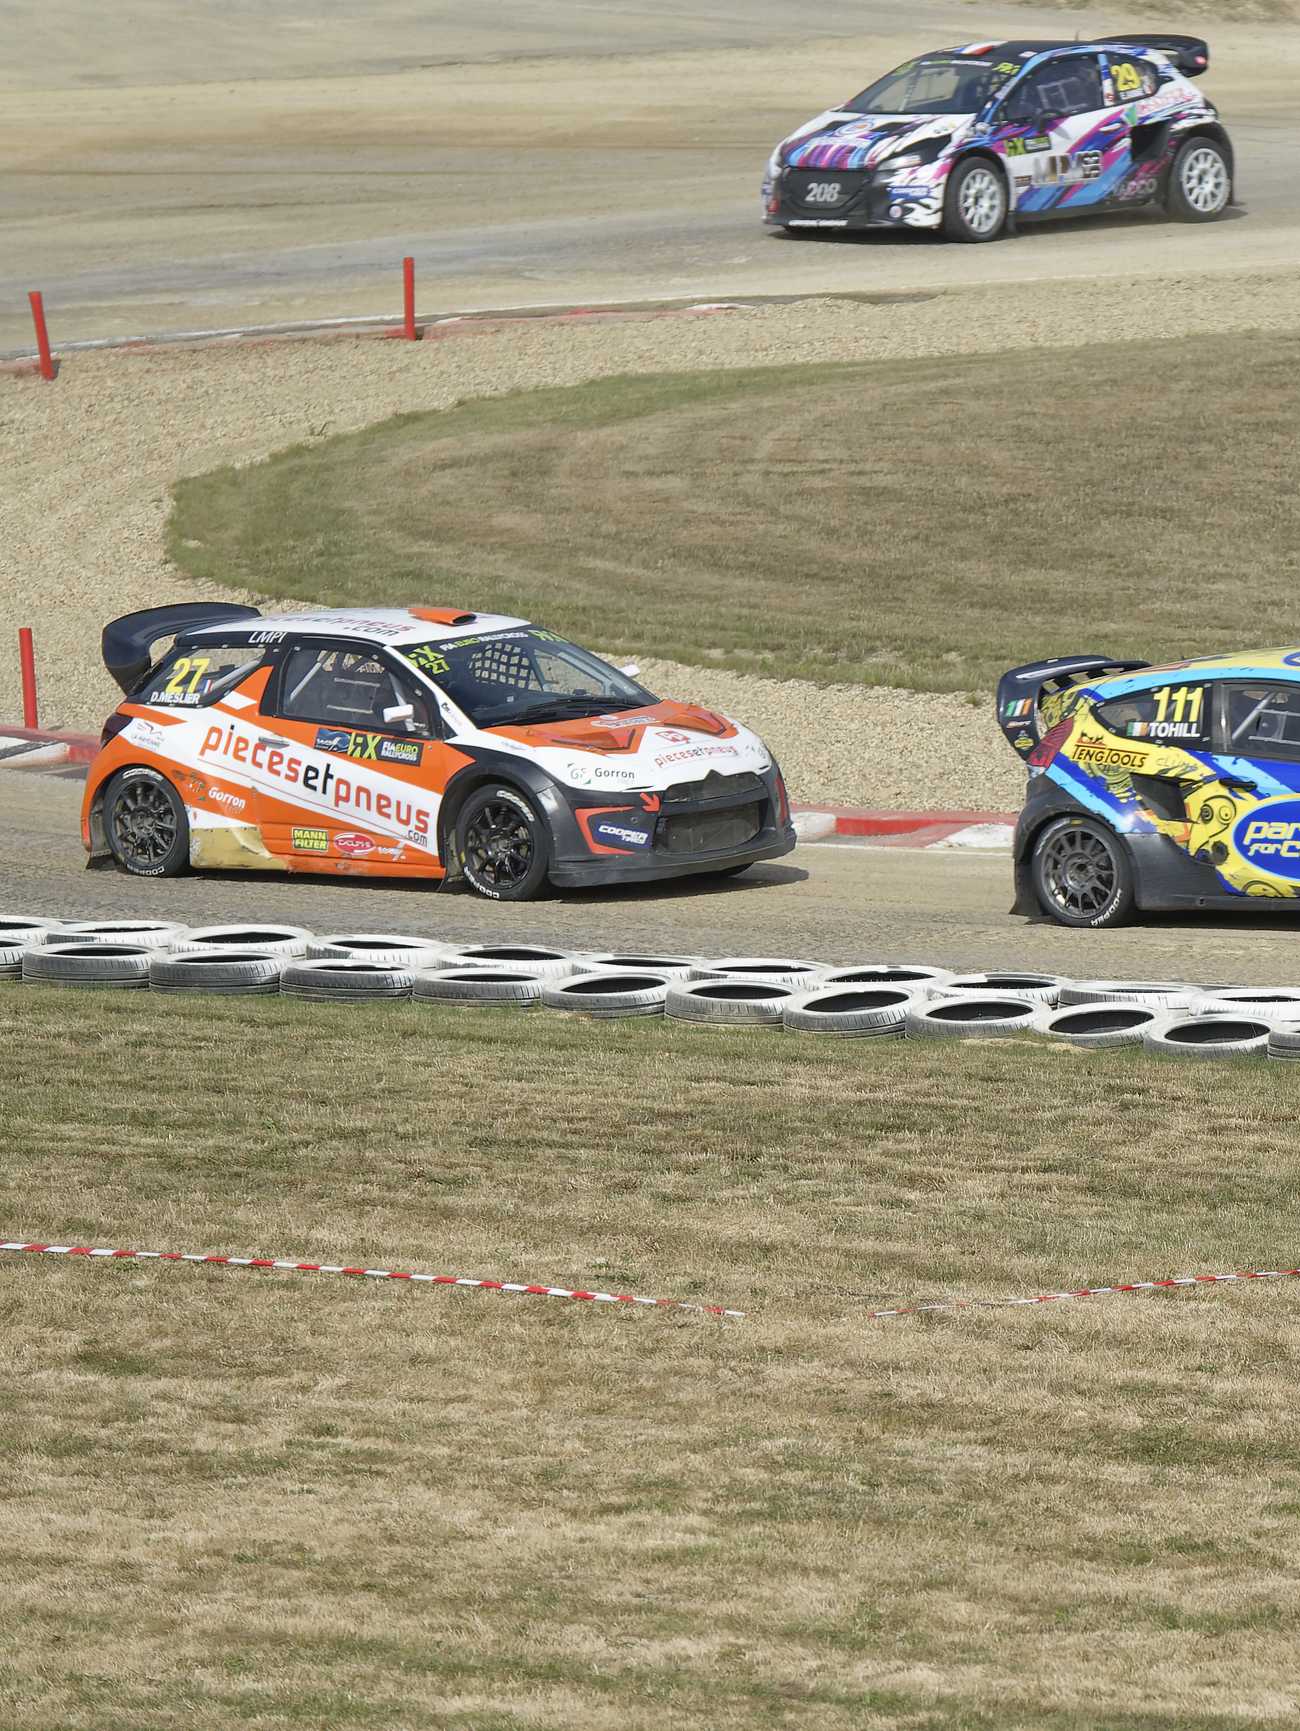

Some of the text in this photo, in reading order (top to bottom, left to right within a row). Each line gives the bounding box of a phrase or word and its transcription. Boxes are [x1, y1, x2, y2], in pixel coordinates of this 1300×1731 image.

[1110, 63, 1140, 91] 29
[805, 183, 841, 201] 208
[248, 631, 288, 643] LMPI
[425, 659, 450, 675] 27
[166, 657, 211, 695] 27
[150, 691, 200, 704] D.MESLIER
[1153, 686, 1204, 722] 111
[1149, 722, 1200, 737] TOHILL
[594, 767, 635, 779] Gorron
[208, 786, 247, 809] Gorron
[293, 829, 327, 840] MANN
[598, 825, 649, 840] COOPER
[294, 838, 327, 850] FILTER
